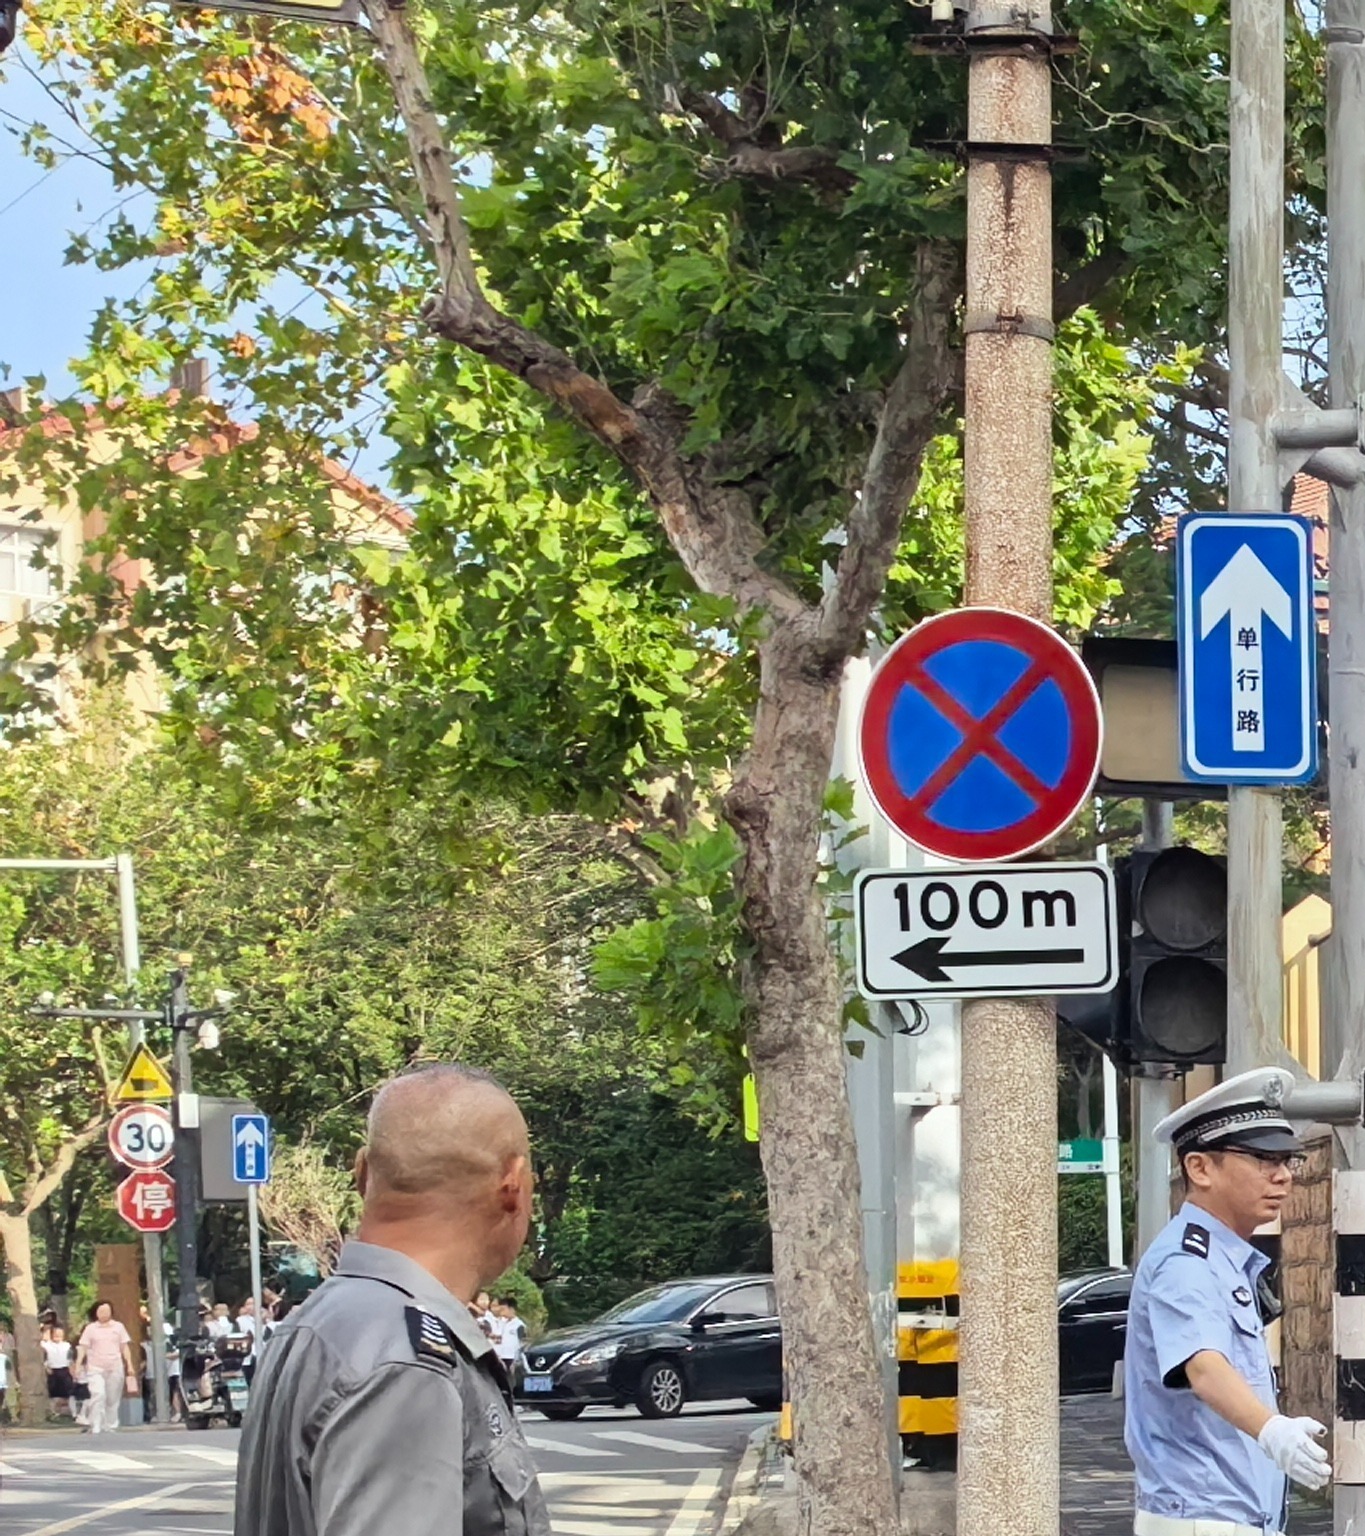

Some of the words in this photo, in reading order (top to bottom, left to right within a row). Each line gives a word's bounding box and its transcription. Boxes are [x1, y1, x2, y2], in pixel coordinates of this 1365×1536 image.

[1236, 628, 1260, 734] 单行路
[893, 880, 1077, 932] 100m
[126, 1123, 166, 1152] 30
[131, 1181, 173, 1220] 停
